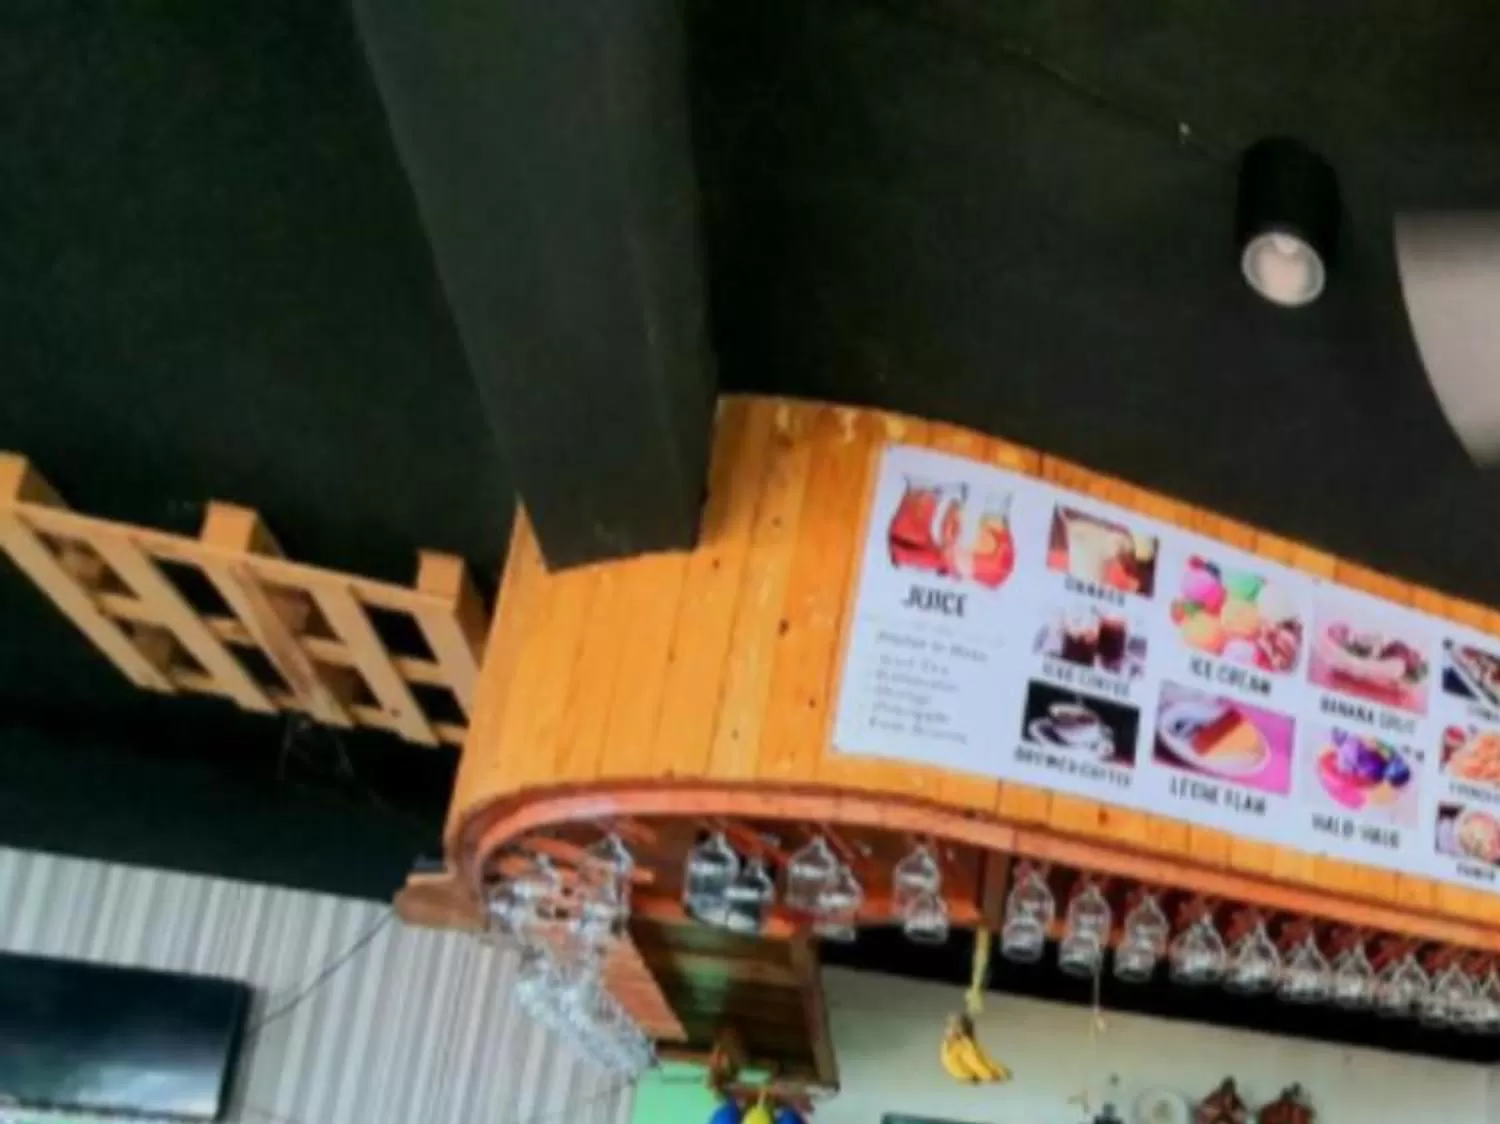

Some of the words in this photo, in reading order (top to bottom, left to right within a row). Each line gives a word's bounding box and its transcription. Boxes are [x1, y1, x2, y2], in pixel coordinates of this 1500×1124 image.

[902, 583, 967, 618] JUICE
[1216, 664, 1272, 696] CREAM
[1223, 788, 1267, 817] FLAN
